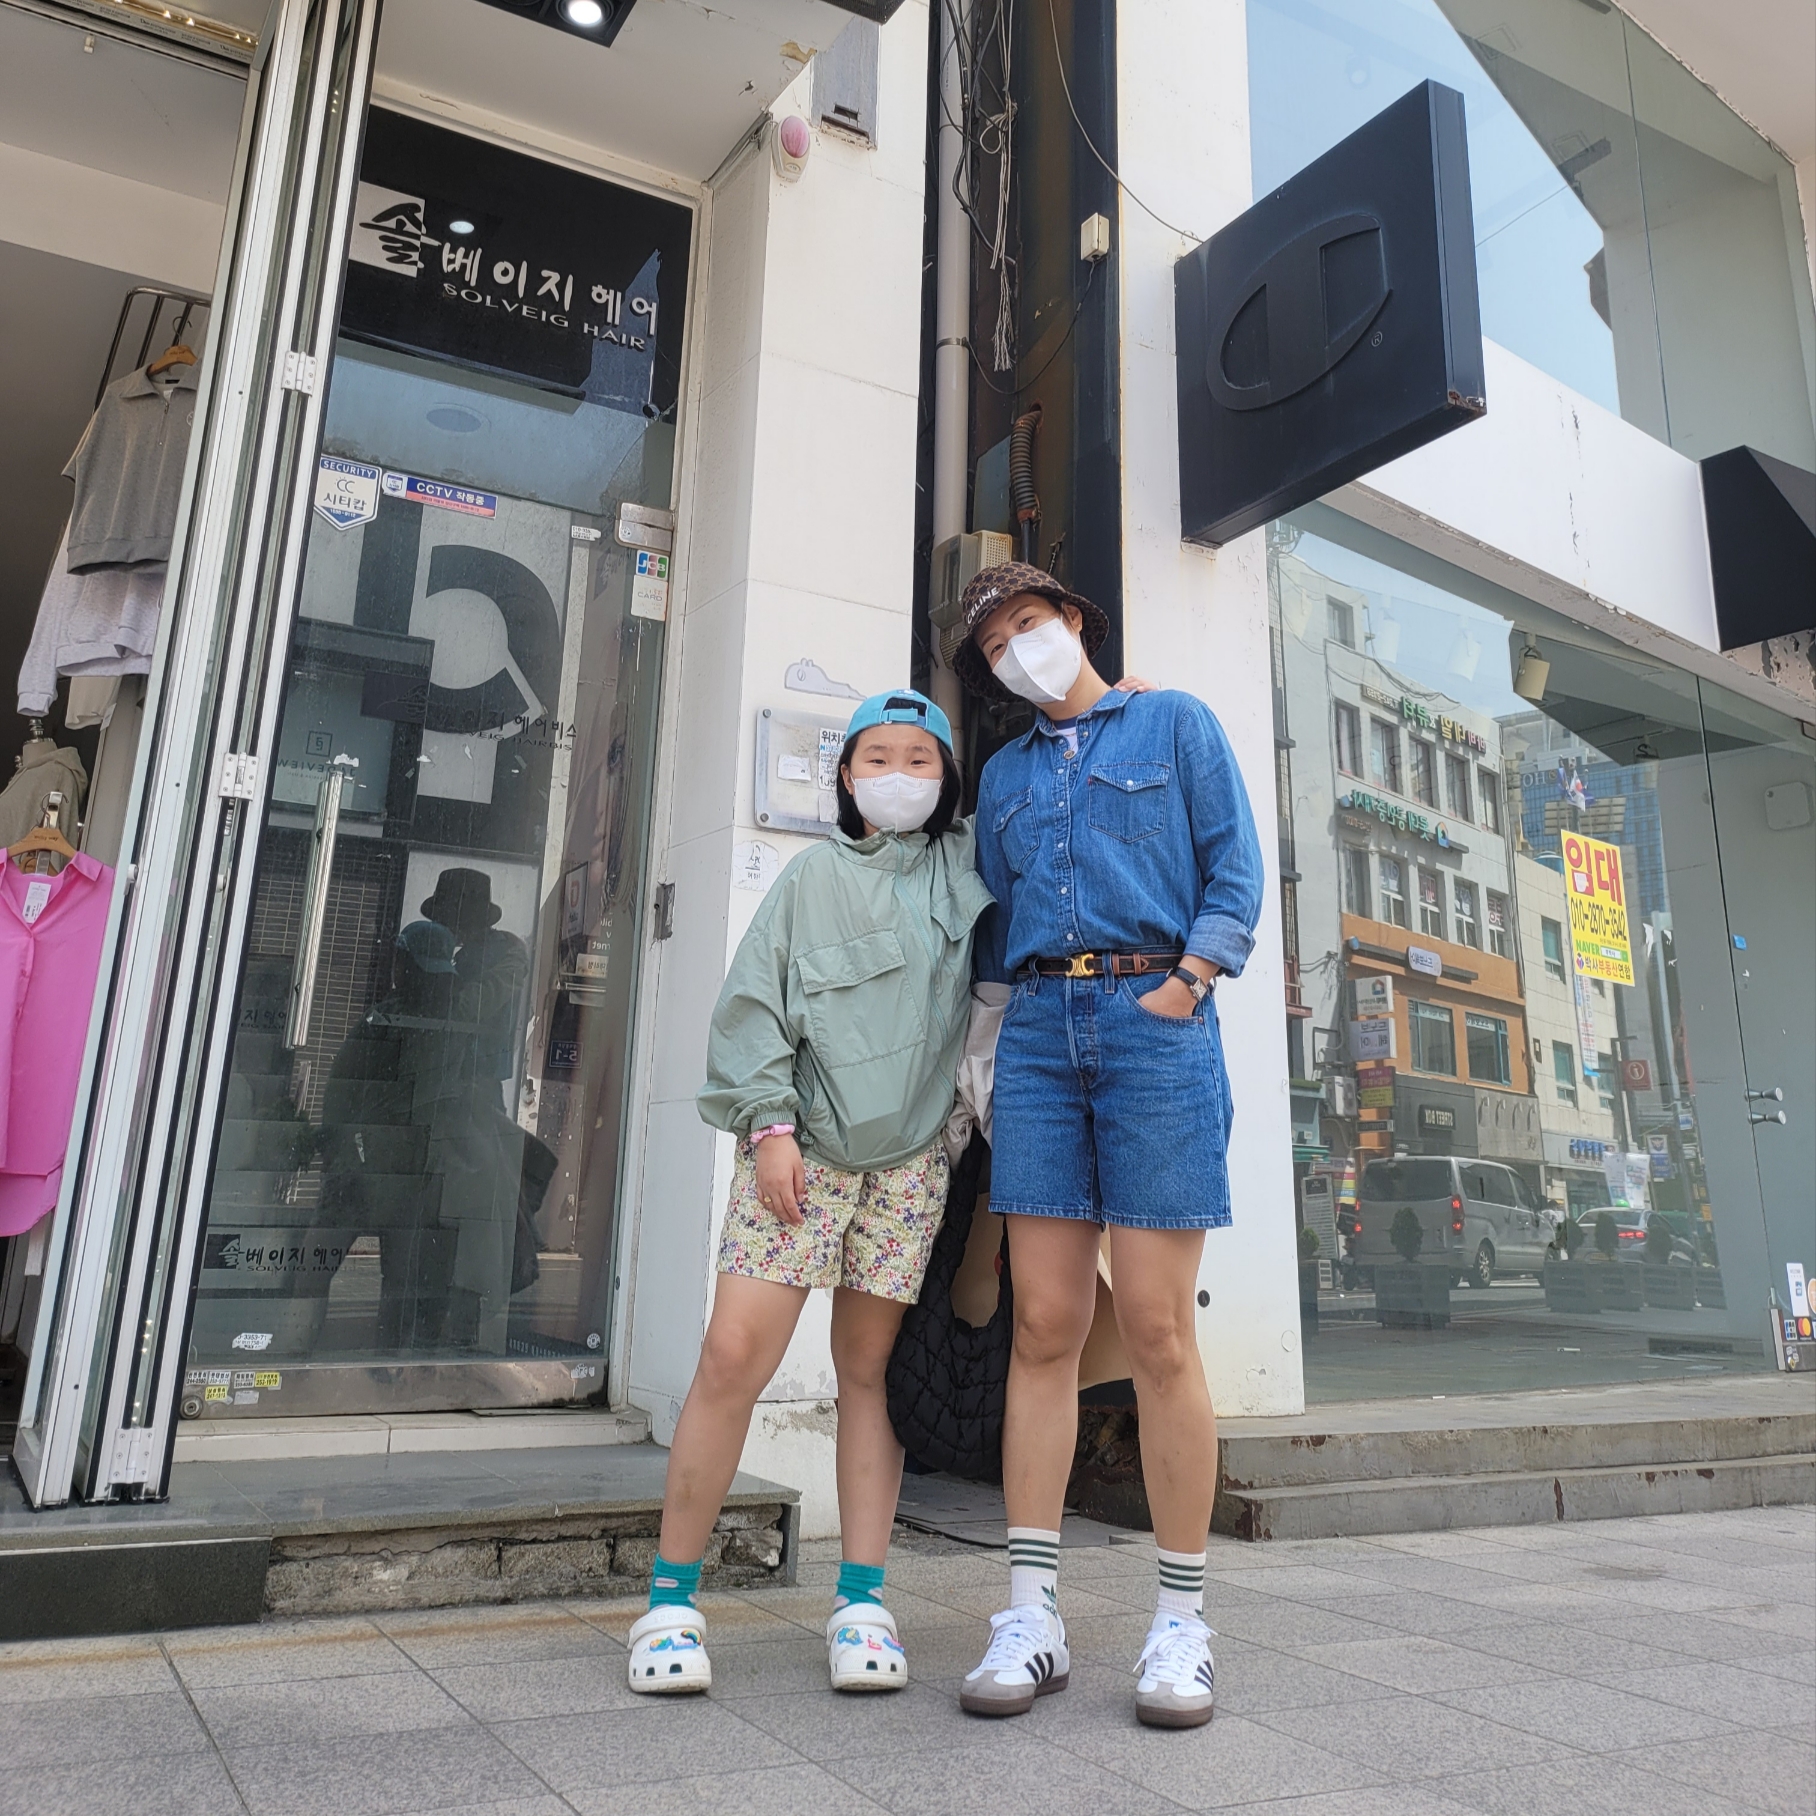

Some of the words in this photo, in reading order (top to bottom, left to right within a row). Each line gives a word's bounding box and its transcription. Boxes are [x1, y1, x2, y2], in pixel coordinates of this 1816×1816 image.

[443, 282, 569, 328] SOLVEIG
[583, 322, 646, 350] HAIR
[591, 283, 657, 336] 헤어
[323, 459, 374, 478] SECURITY
[416, 482, 454, 499] CCTV
[636, 552, 667, 578] JCB
[967, 586, 1000, 625] CELINE
[1565, 837, 1623, 906] 임대
[1575, 938, 1601, 957] NAVER
